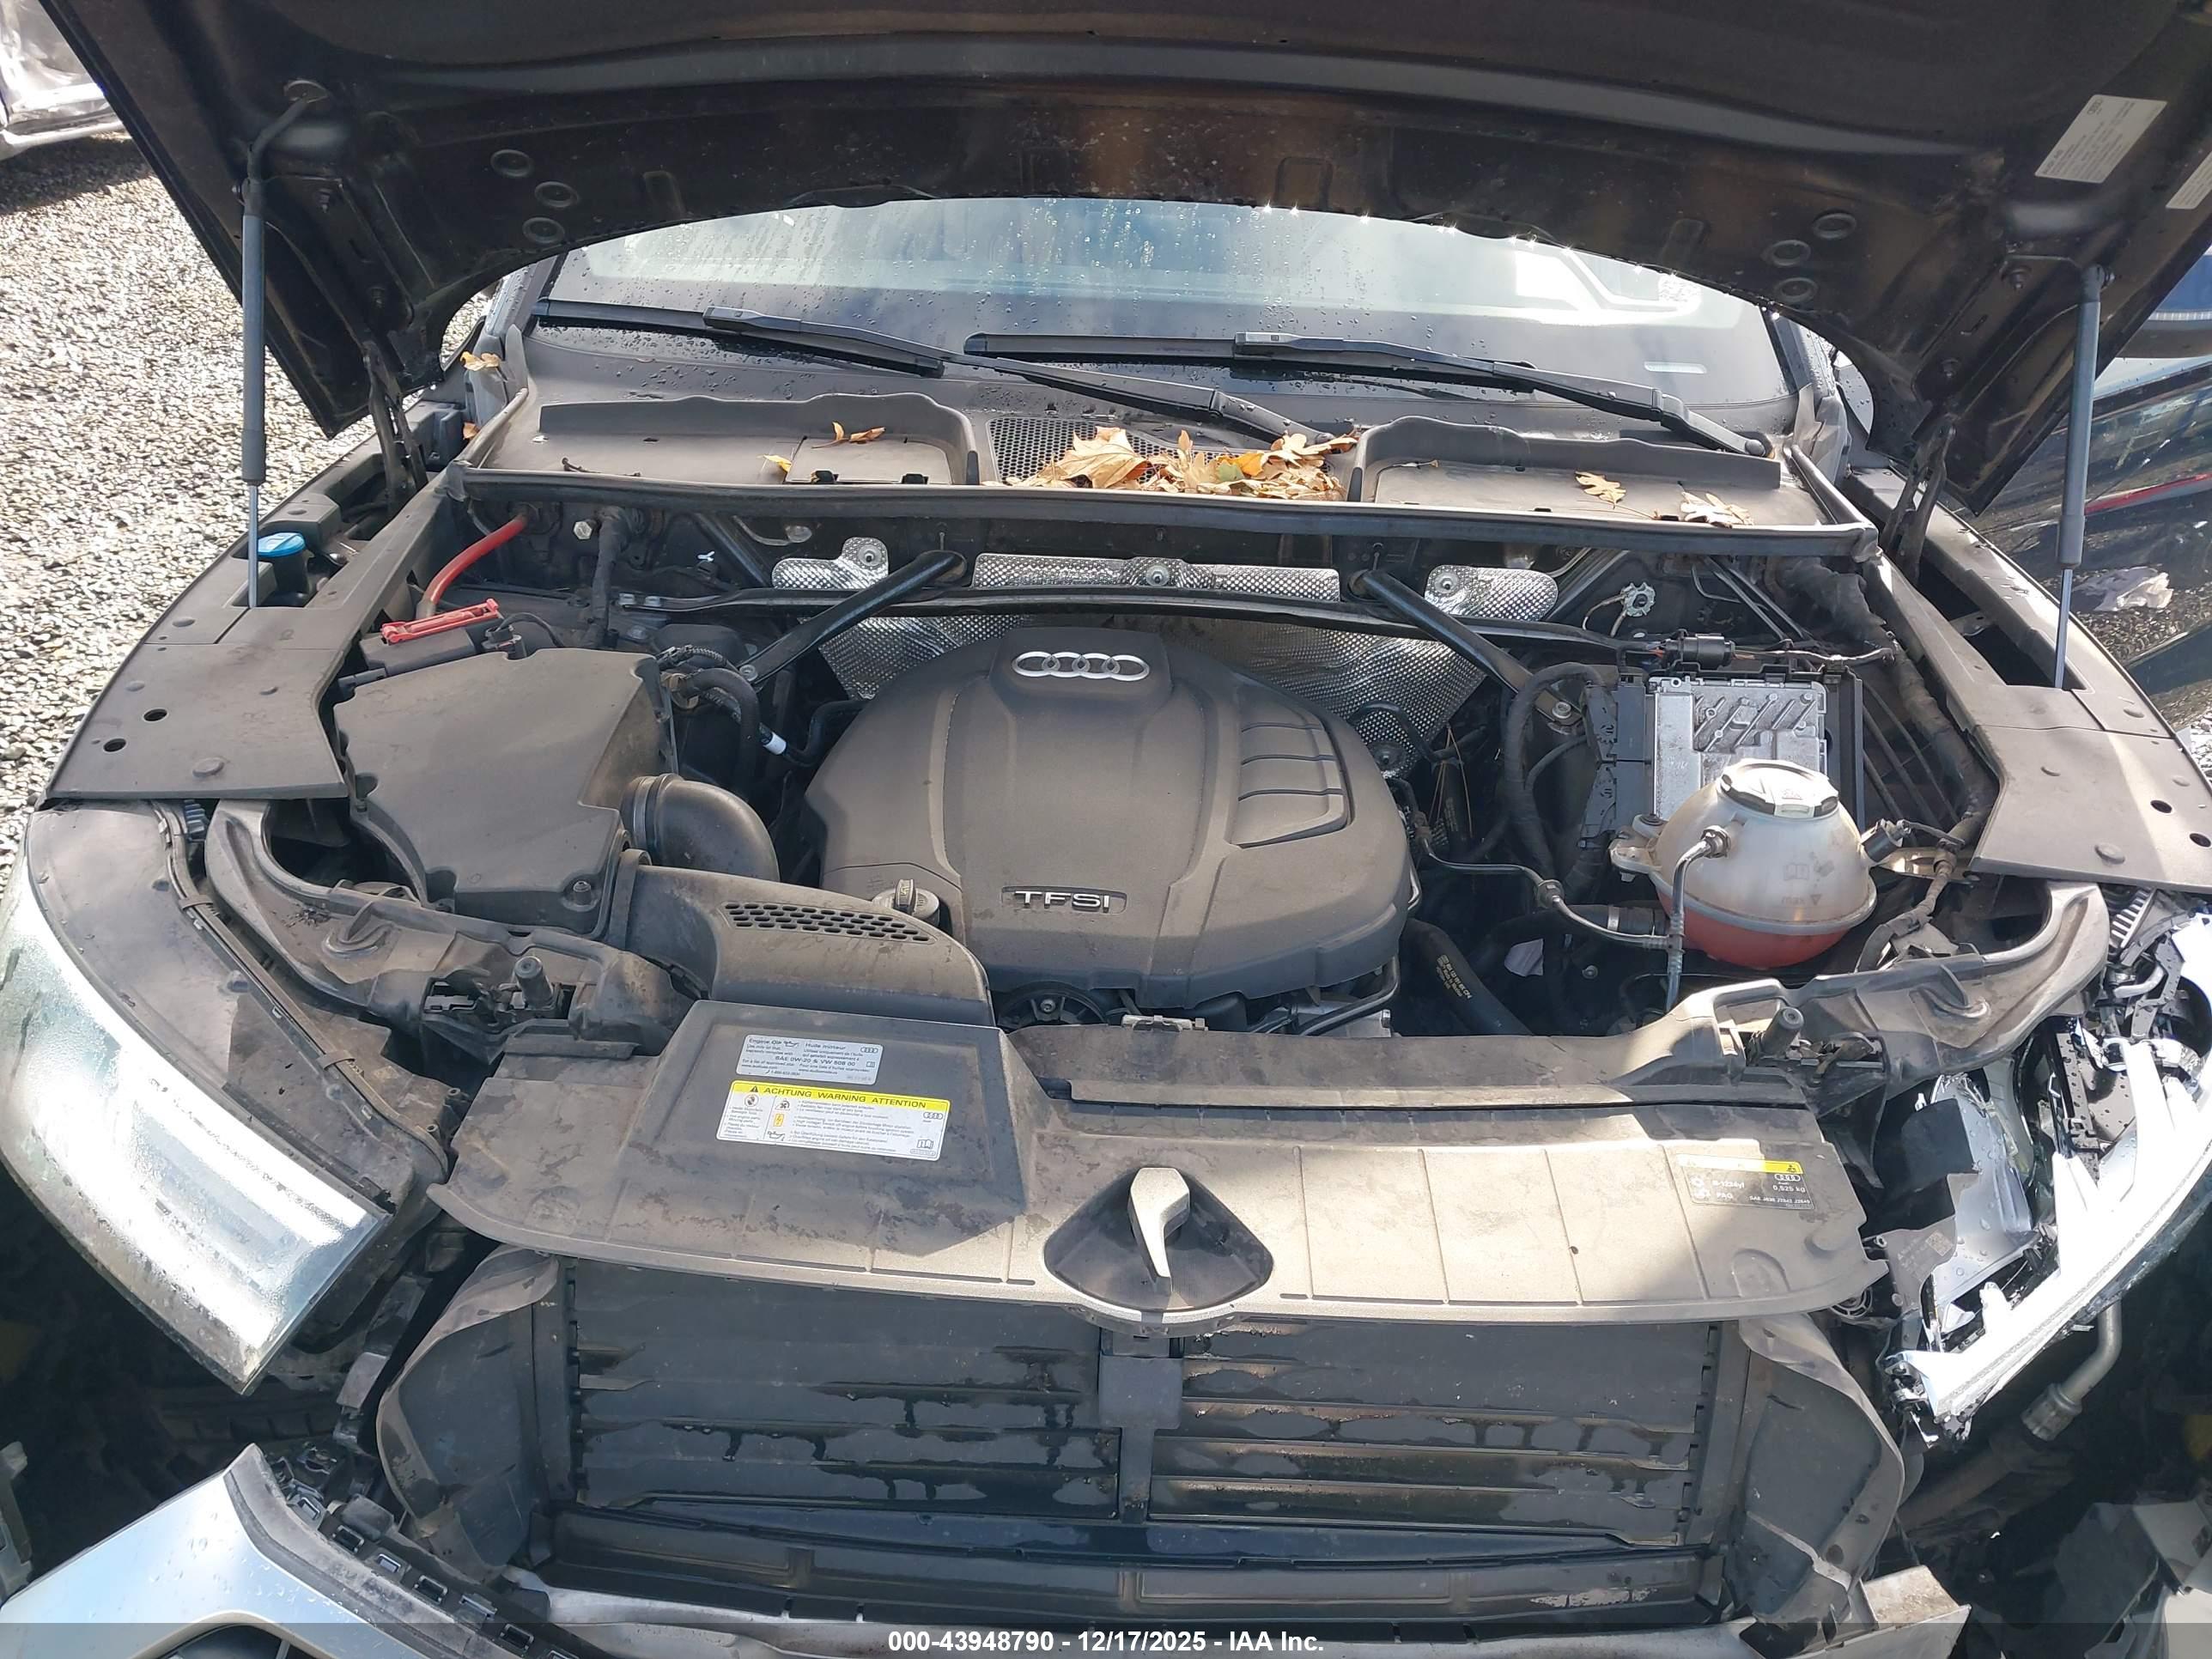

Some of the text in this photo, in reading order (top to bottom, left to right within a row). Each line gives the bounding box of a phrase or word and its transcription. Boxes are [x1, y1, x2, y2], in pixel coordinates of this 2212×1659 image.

[1013, 891, 1110, 911] TFSI
[763, 1087, 812, 1097] ACHTUNG
[817, 1092, 866, 1103] WARNING
[872, 1097, 927, 1109] ATTENTION
[1717, 1191, 1733, 1200] PAG
